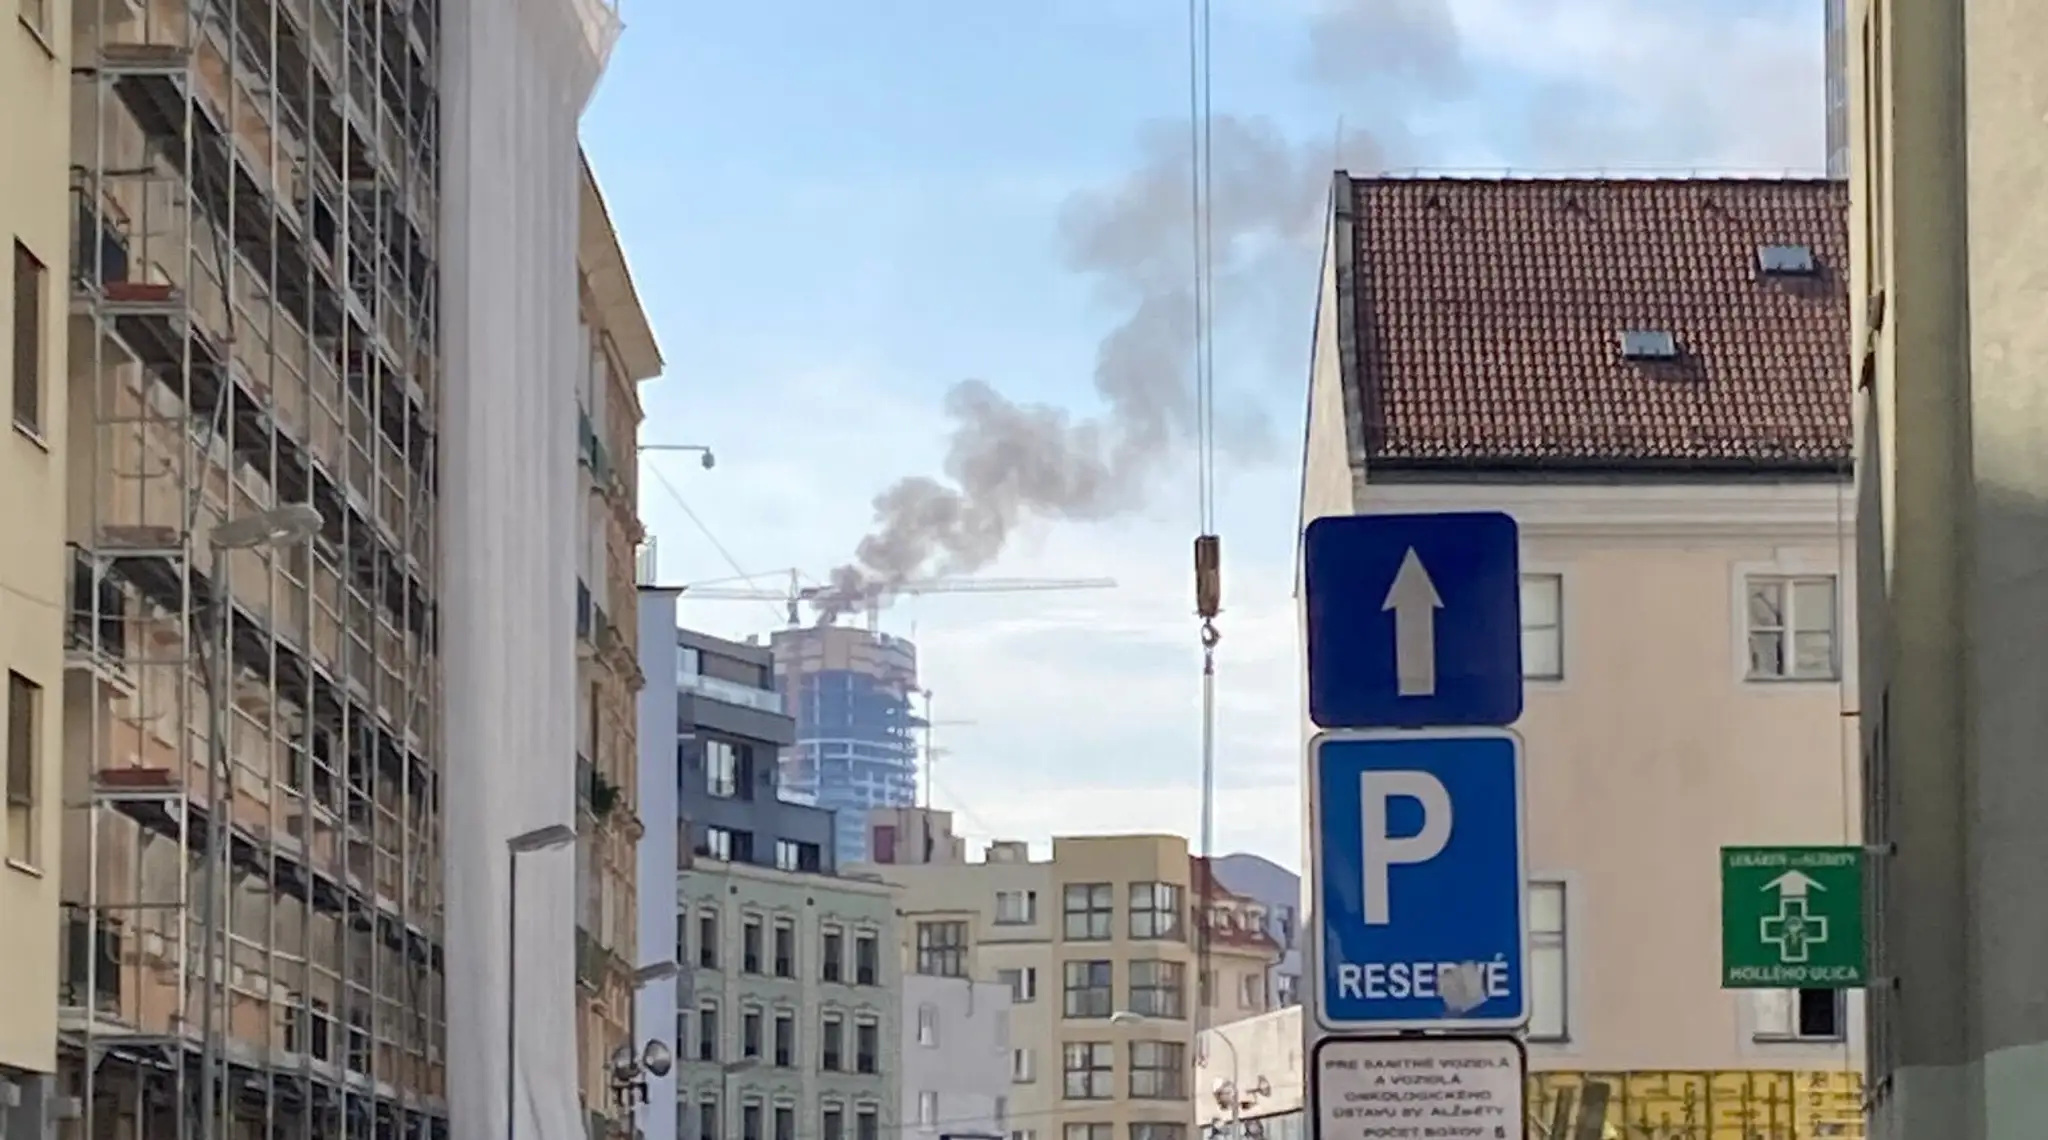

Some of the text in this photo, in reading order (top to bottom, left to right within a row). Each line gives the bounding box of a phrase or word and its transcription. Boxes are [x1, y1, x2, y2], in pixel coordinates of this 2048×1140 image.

[1360, 769, 1454, 926] P
[1337, 952, 1511, 1000] RESEÉ
[1809, 966, 1860, 982] ULICA
[1325, 1059, 1358, 1070] PRE
[1374, 1075, 1386, 1086] A
